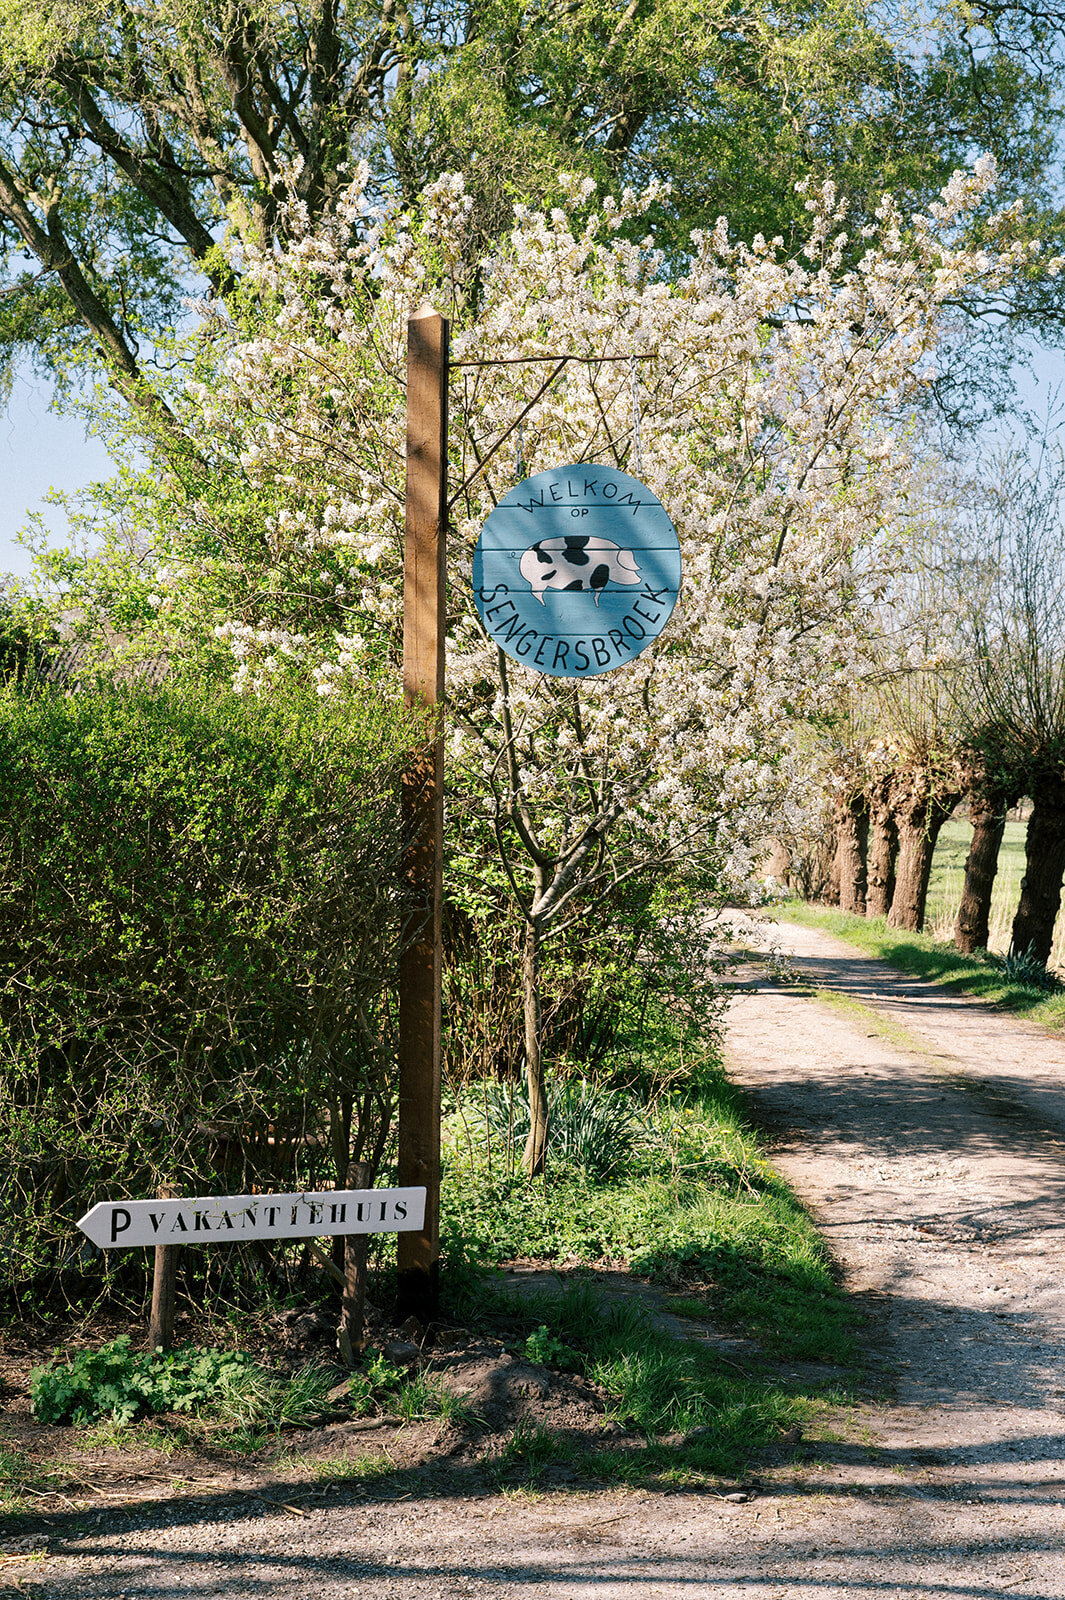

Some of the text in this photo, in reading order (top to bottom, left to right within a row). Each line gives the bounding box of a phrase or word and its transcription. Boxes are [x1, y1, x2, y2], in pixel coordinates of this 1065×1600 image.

[517, 479, 642, 516] WELKOM
[570, 508, 590, 518] OP
[479, 582, 669, 671] SENGERSBROEK
[110, 1200, 409, 1243] P VAKANTIEHUIS
